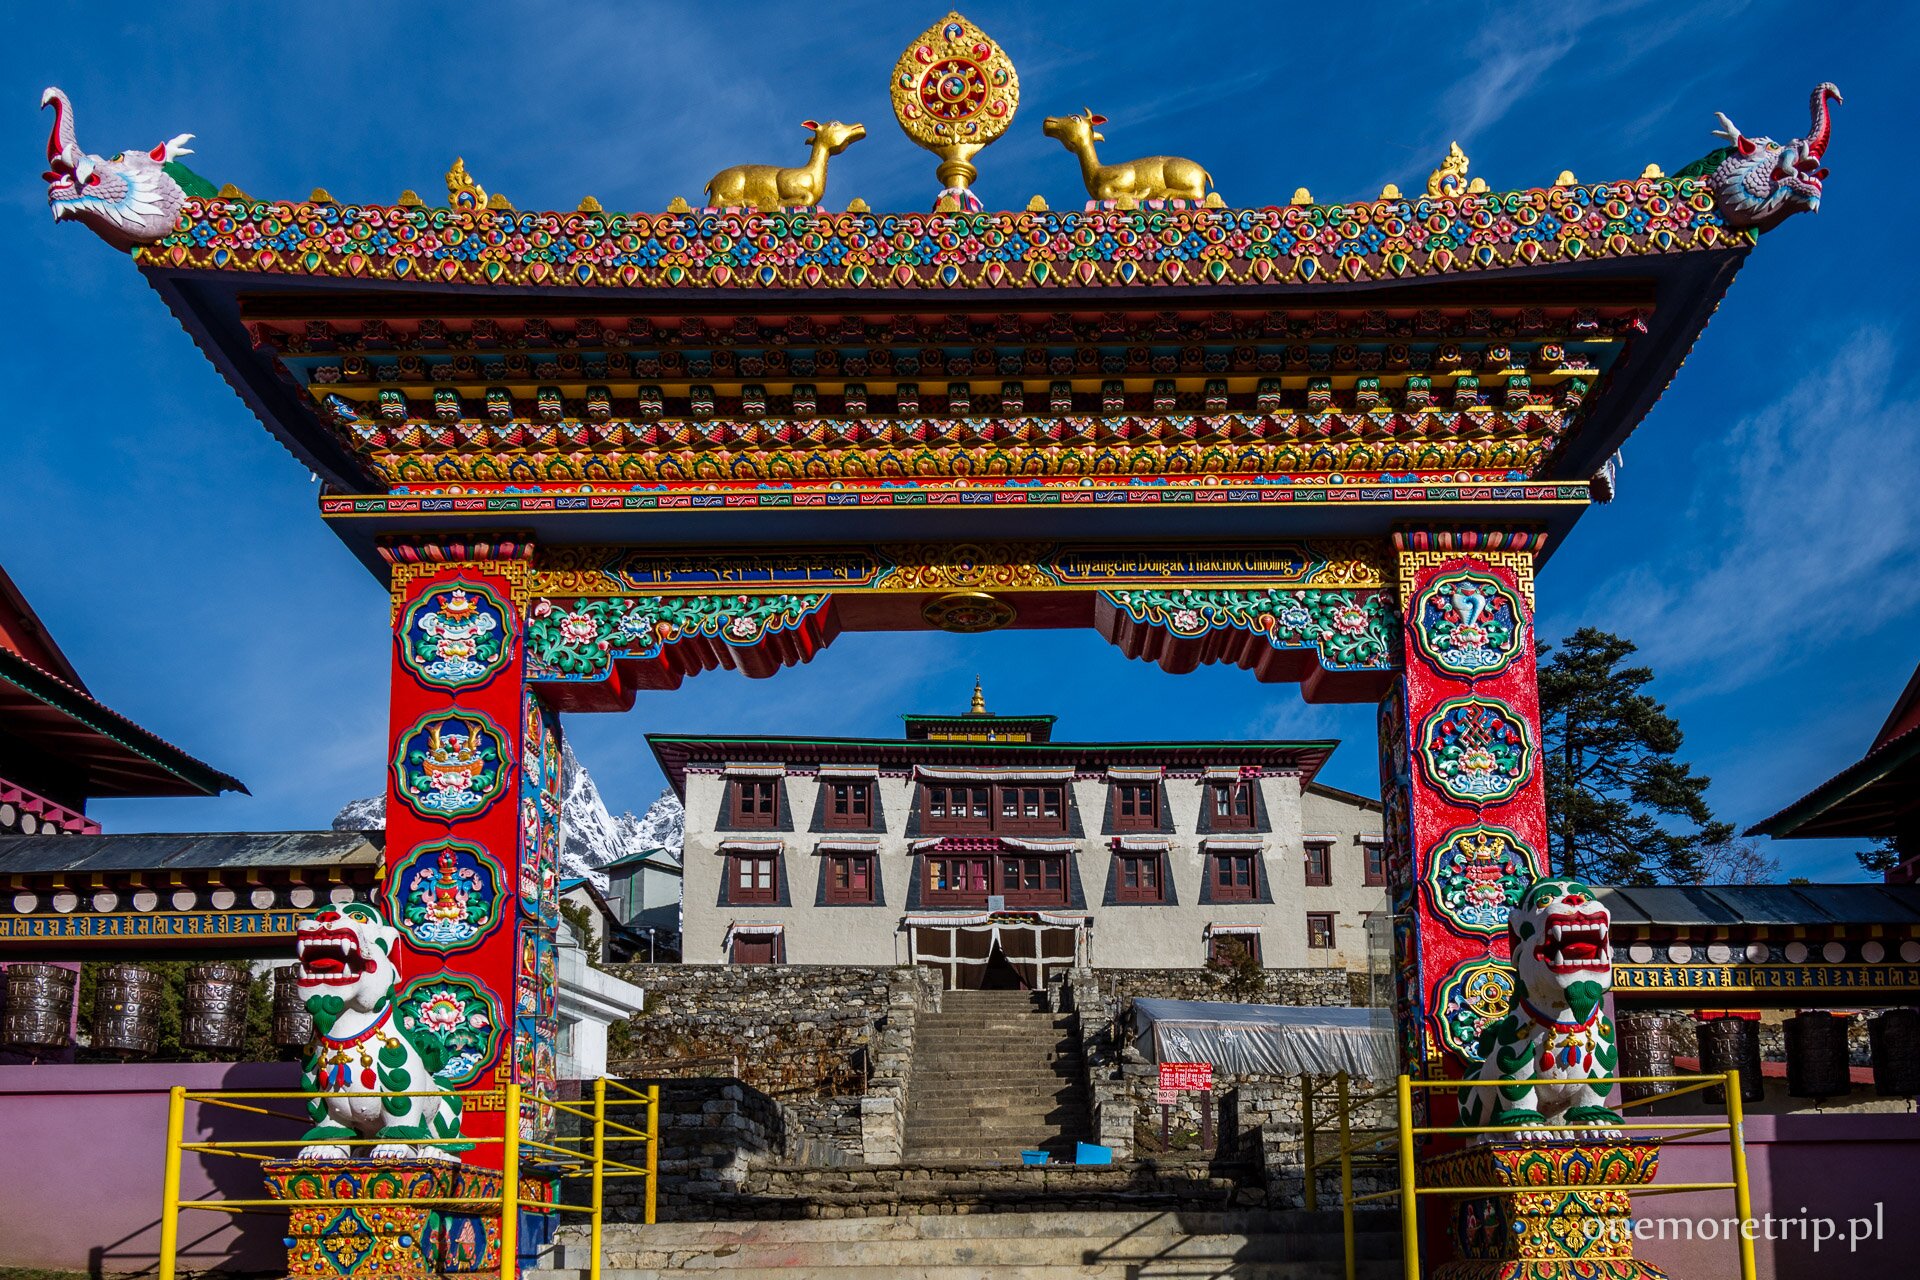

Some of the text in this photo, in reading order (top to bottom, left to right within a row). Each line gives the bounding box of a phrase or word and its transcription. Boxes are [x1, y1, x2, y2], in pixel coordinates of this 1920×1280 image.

[1068, 551, 1293, 576] Thyangche Dongak Thakchok Chholing
